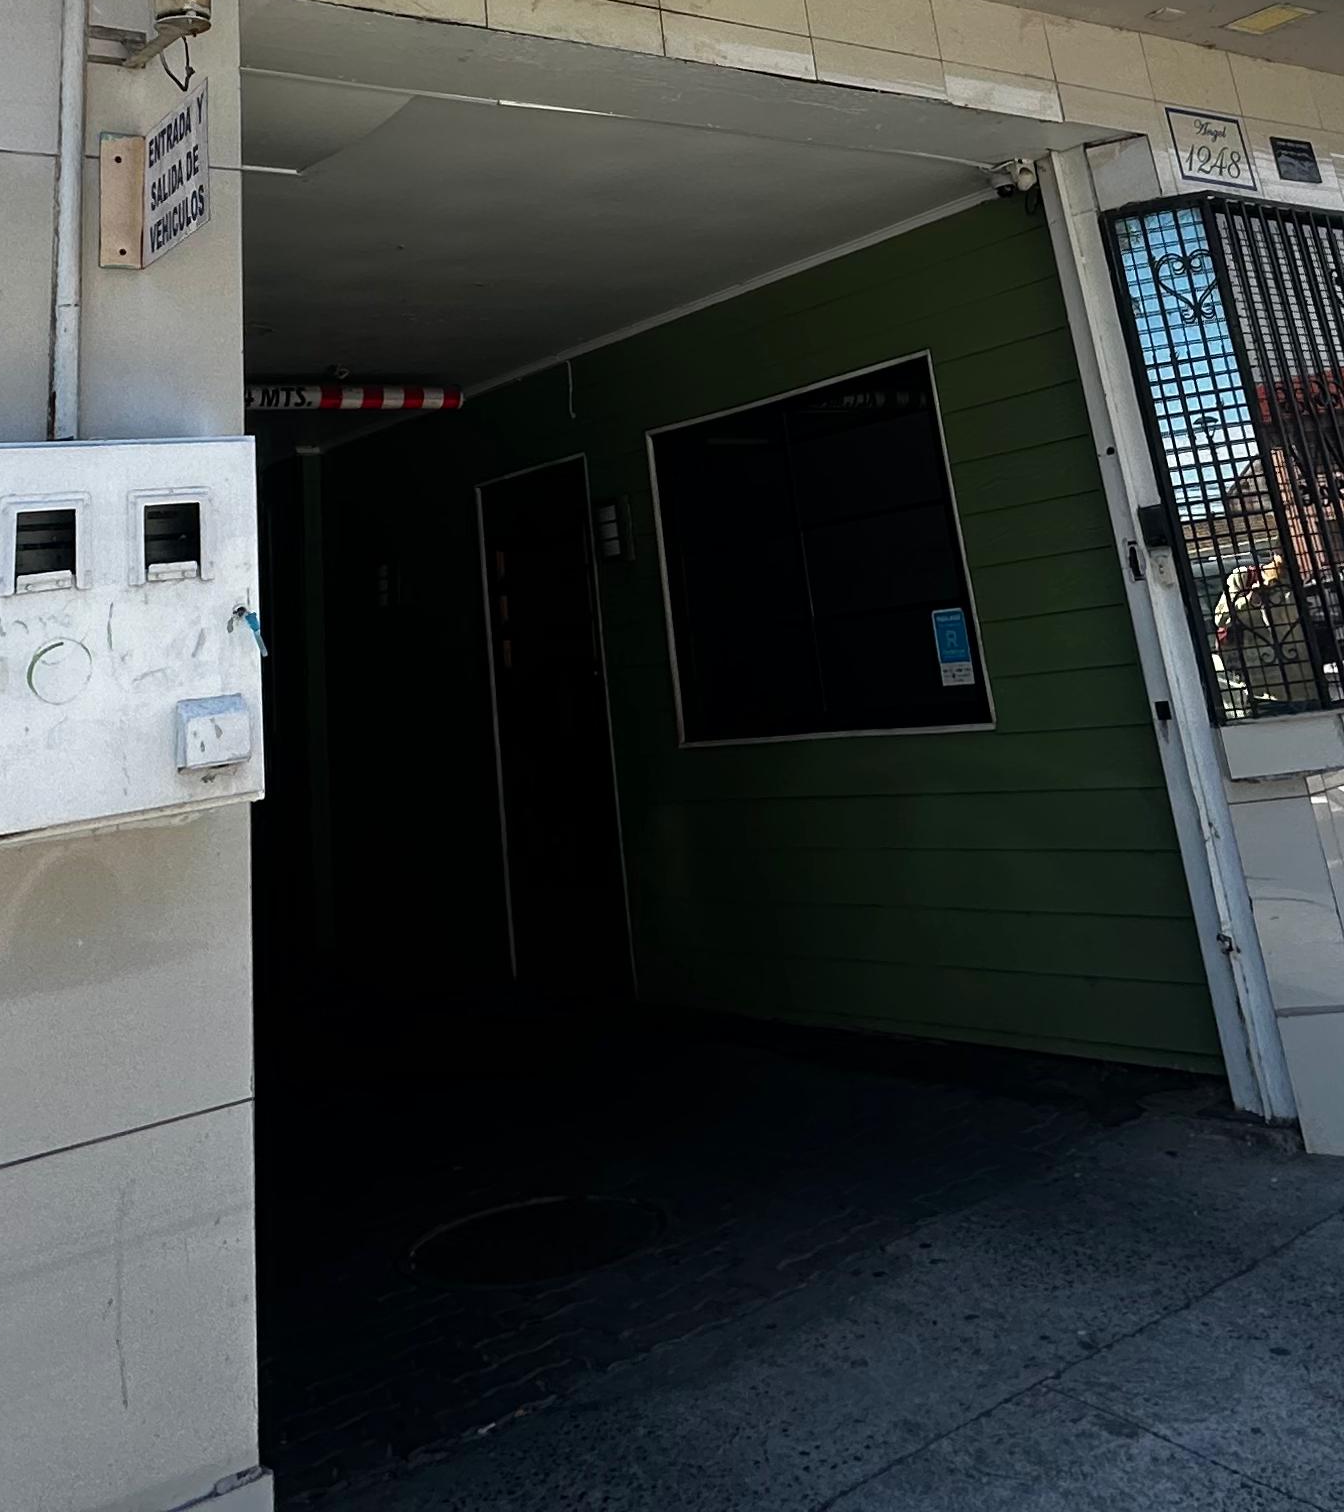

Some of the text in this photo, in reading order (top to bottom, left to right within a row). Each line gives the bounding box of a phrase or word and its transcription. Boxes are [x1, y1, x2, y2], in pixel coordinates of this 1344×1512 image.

[148, 92, 205, 169] ENTRADA Y
[1185, 144, 1241, 179] 1248
[150, 144, 199, 211] SALIDA DE
[149, 184, 205, 253] VEHICULOS
[260, 387, 312, 407] MTS.
